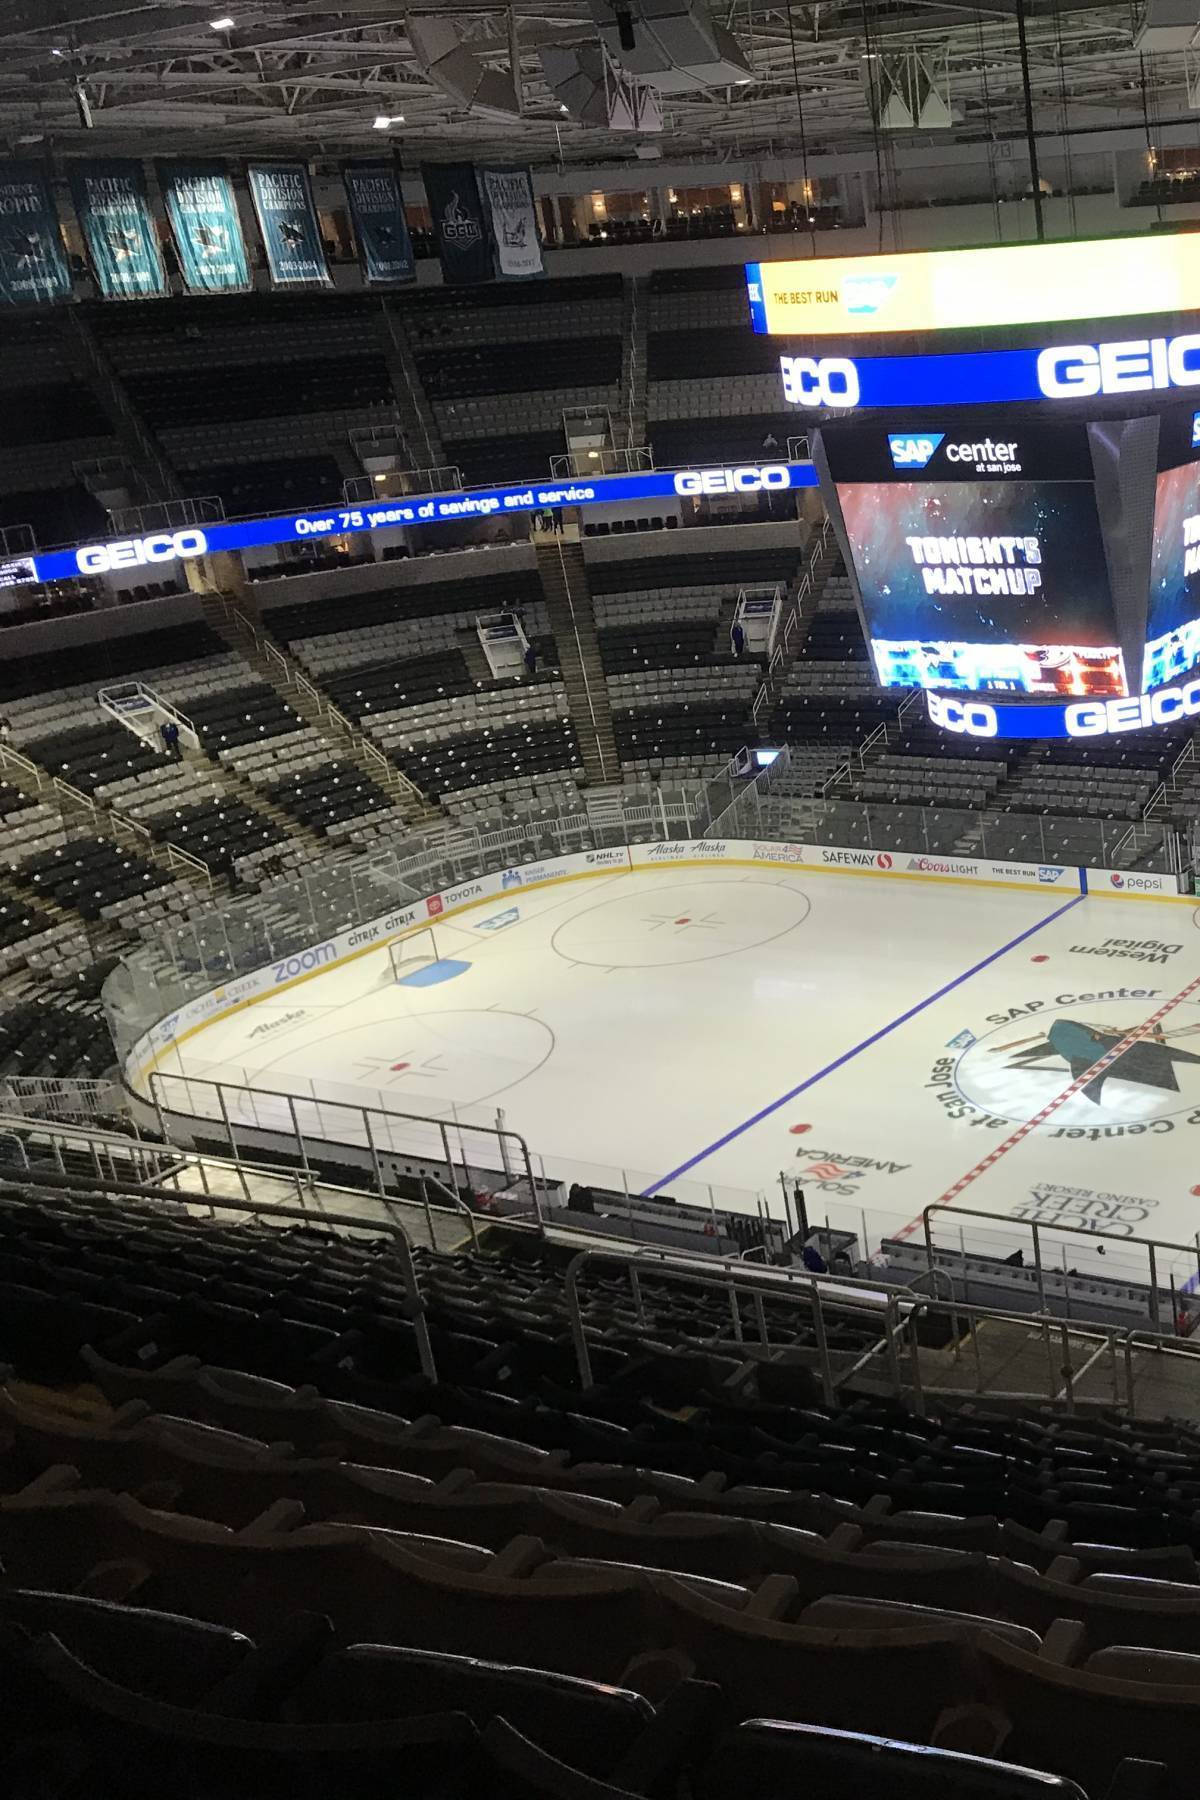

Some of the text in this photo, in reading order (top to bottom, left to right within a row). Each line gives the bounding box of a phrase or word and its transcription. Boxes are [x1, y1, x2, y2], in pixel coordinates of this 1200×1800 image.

[85, 177, 133, 193] PACIFIC
[174, 176, 220, 190] PACIFIC
[257, 173, 301, 189] PACIFIC
[352, 177, 392, 192] PACIFIC
[89, 193, 137, 206] DIVISION
[177, 190, 222, 204] DIVISION
[260, 188, 305, 202] DIVISION
[355, 191, 395, 204] DIVISION
[263, 201, 306, 210] CHAMPIONS
[773, 292, 789, 304] THE
[790, 291, 812, 304] BEST
[815, 289, 838, 303] RUN
[889, 438, 1018, 464] SAP center
[975, 462, 1022, 475] at san jose
[673, 465, 791, 496] GEICO
[294, 486, 595, 535] Over 75 years of savings and service
[75, 529, 208, 575] GEICO
[906, 536, 1043, 564] TONIGHT'S
[921, 568, 1042, 596] MATCHUP
[648, 844, 686, 855] Alaska
[690, 841, 726, 852] Alaska
[753, 850, 804, 863] AMERICA
[823, 851, 875, 866] SAFEWAY
[917, 858, 978, 875] Coors LIGHT
[992, 867, 1004, 875] THE
[1005, 868, 1021, 876] BEST
[1038, 868, 1060, 881] SAP
[1127, 877, 1162, 890] pepsi
[445, 885, 483, 904] TOYOTA
[385, 911, 416, 931] CITRIX
[348, 926, 380, 947] CITRIX
[1101, 938, 1184, 954] Digital
[1068, 945, 1169, 964] Western
[271, 942, 337, 984] zoom
[985, 1000, 1045, 1025] SAP
[1055, 987, 1163, 1006] Center
[924, 1057, 956, 1089] Jose
[936, 1092, 976, 1119] San
[969, 1113, 1009, 1129] at
[1048, 1119, 1175, 1141] Center
[796, 1147, 912, 1174] AMERICA
[1032, 1182, 1160, 1208] RESORT CASINO
[1021, 1190, 1150, 1222] CREEK
